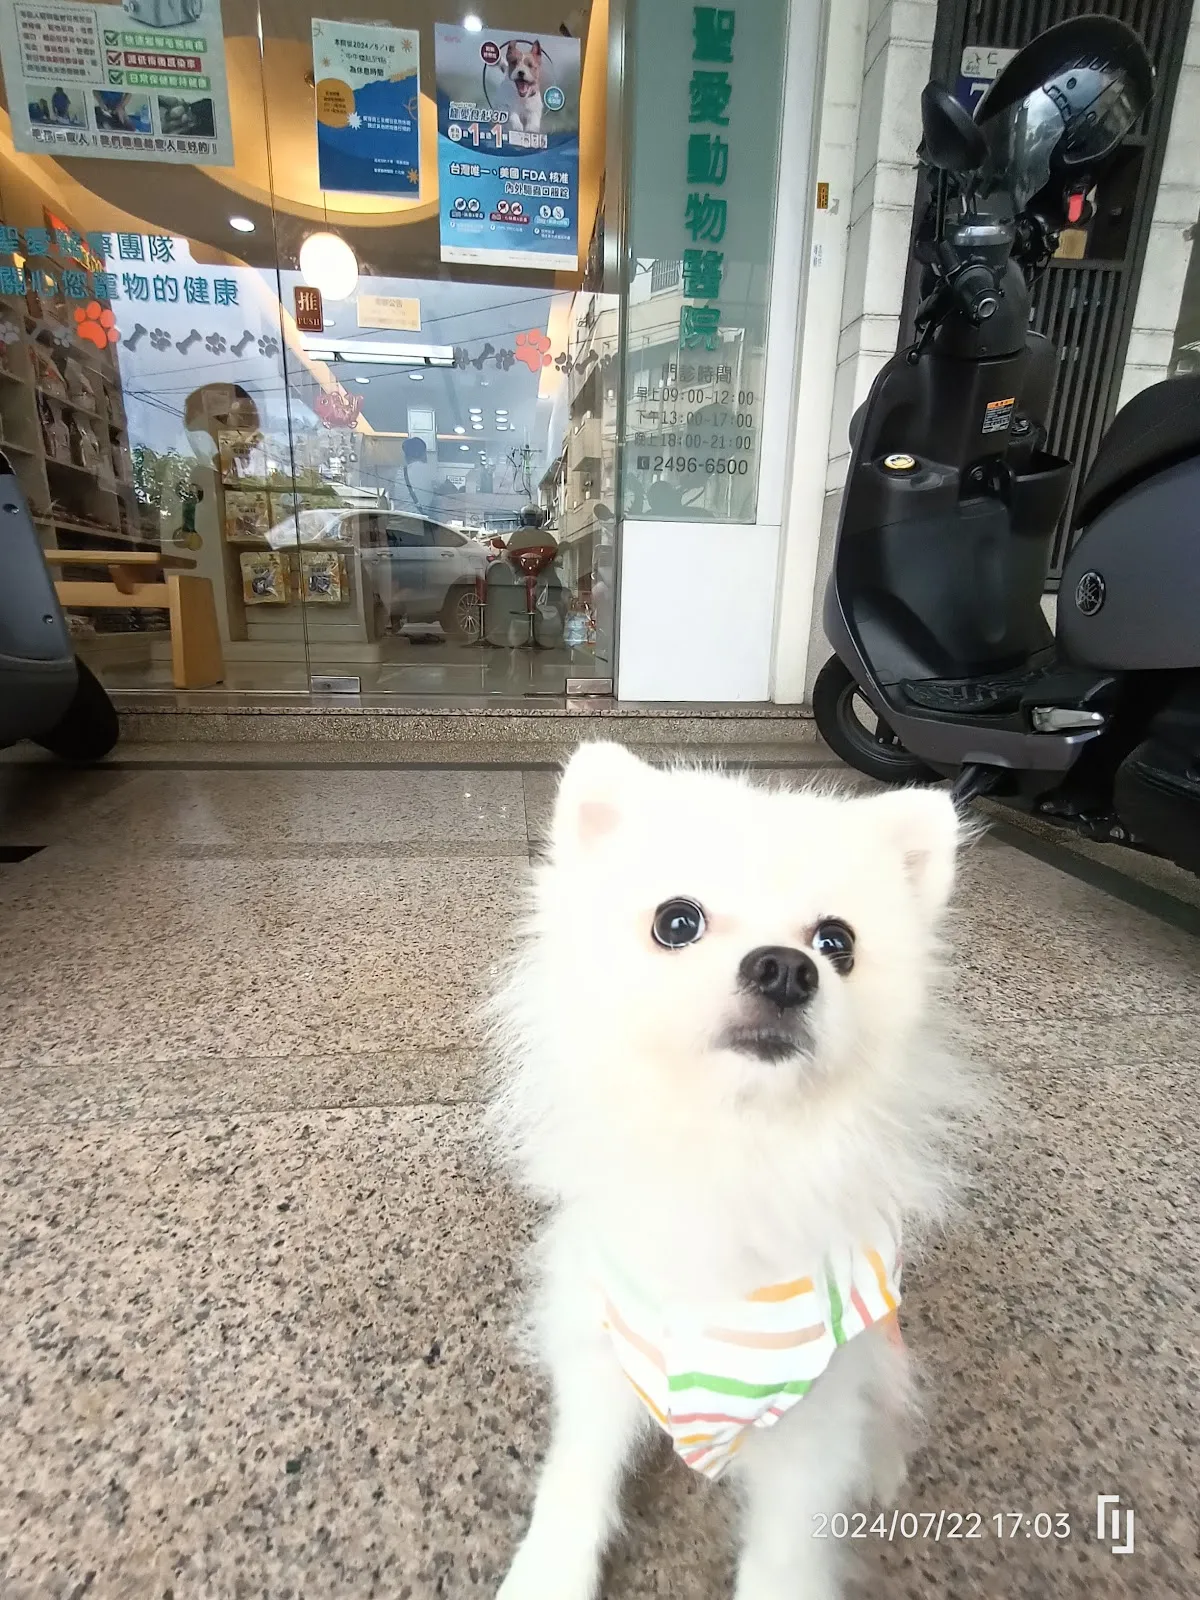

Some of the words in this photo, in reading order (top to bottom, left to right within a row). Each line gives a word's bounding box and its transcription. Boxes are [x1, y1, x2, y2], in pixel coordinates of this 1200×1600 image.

[522, 169, 547, 181] FDA
[549, 171, 569, 184] 核准
[679, 7, 735, 351] 聖愛動物醫院
[0, 266, 240, 306] 關心您寵物的健康
[298, 291, 318, 311] 推
[298, 317, 320, 326] PUSH
[662, 363, 732, 384] 門診時間
[653, 455, 749, 475] 2496-6500
